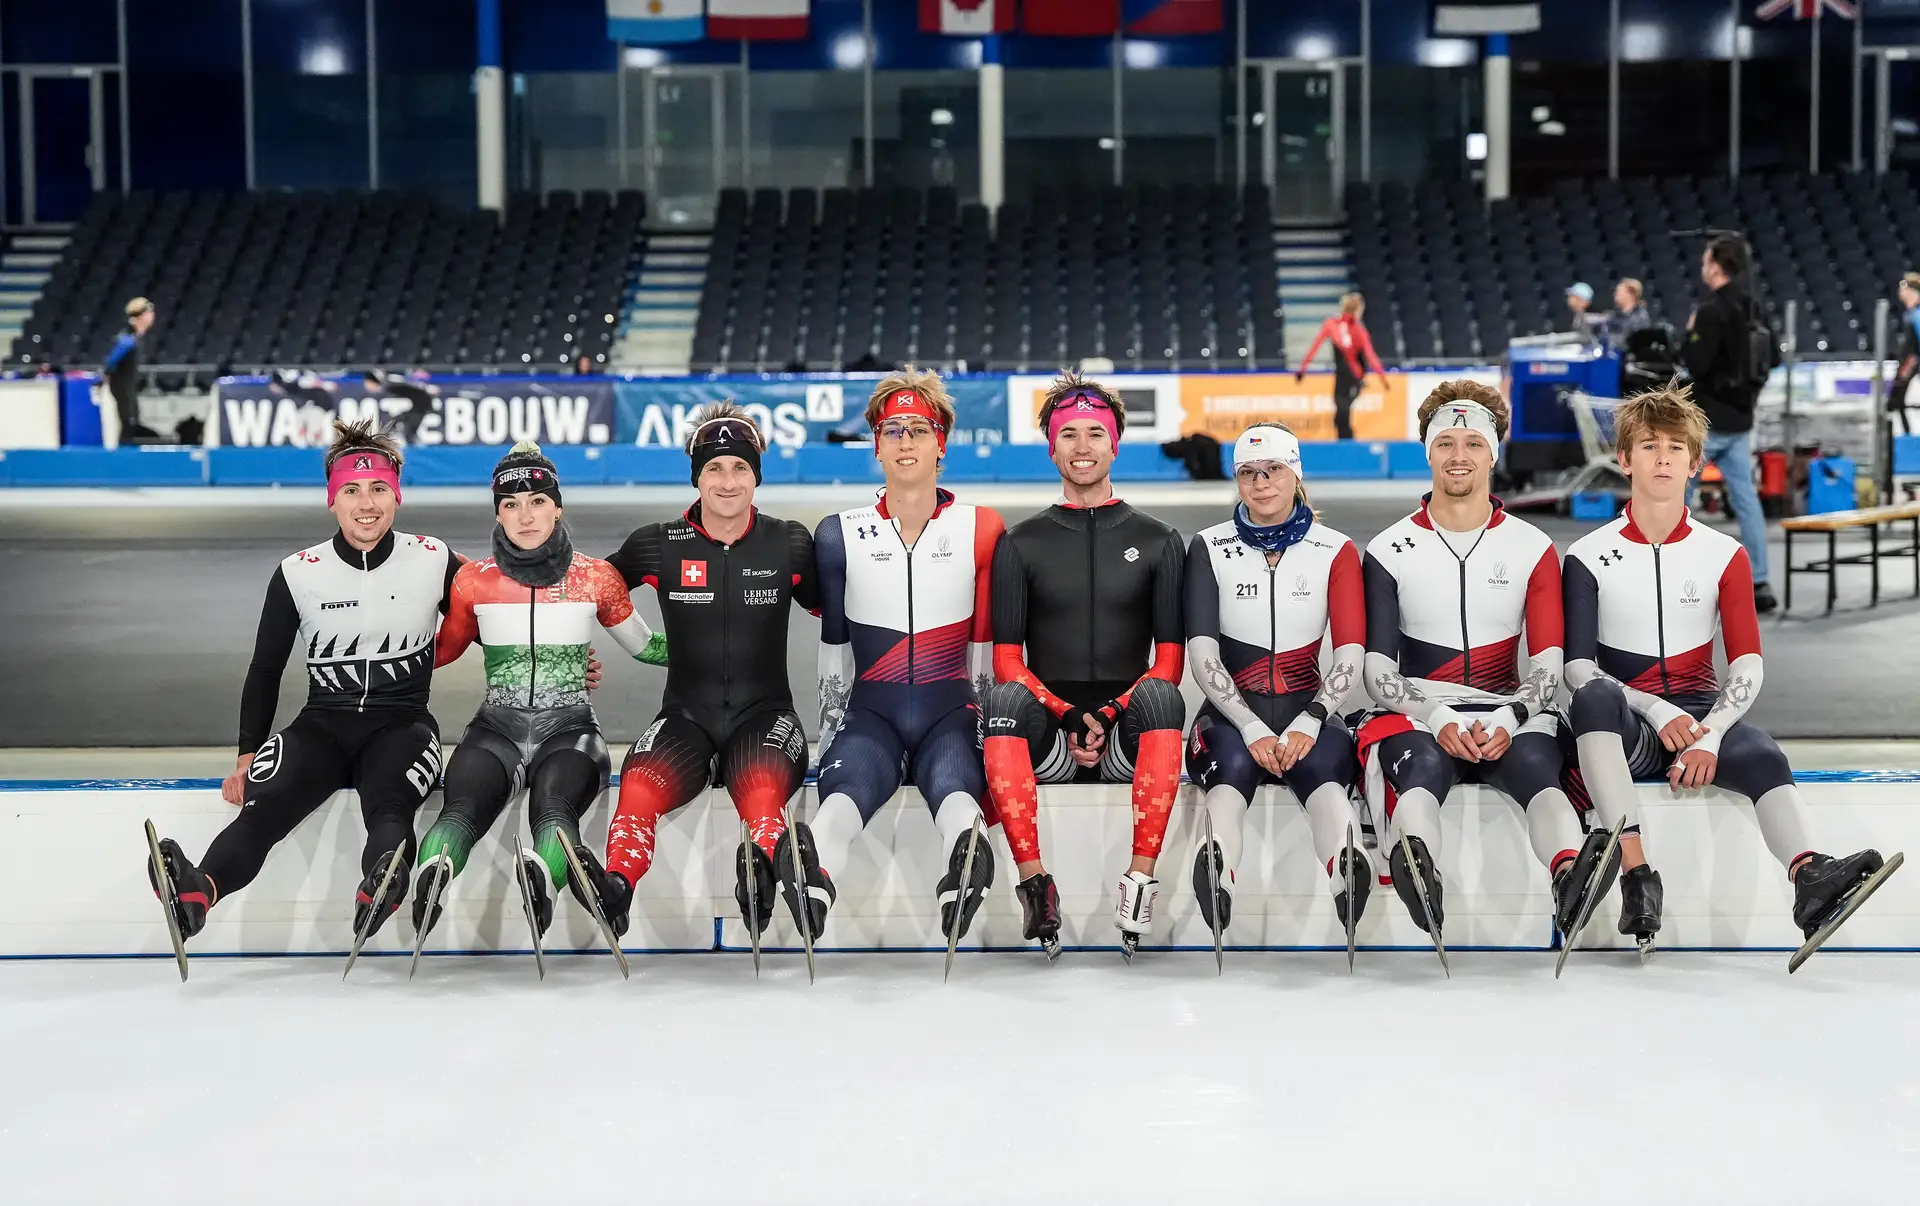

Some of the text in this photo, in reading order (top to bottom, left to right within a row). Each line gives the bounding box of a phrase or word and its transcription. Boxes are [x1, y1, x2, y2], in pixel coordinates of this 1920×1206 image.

[499, 469, 532, 485] SUISSE
[668, 532, 696, 541] COLLECTIVE
[743, 589, 778, 598] LEHNER
[1236, 583, 1258, 596] 211
[743, 597, 778, 605] VERSAND
